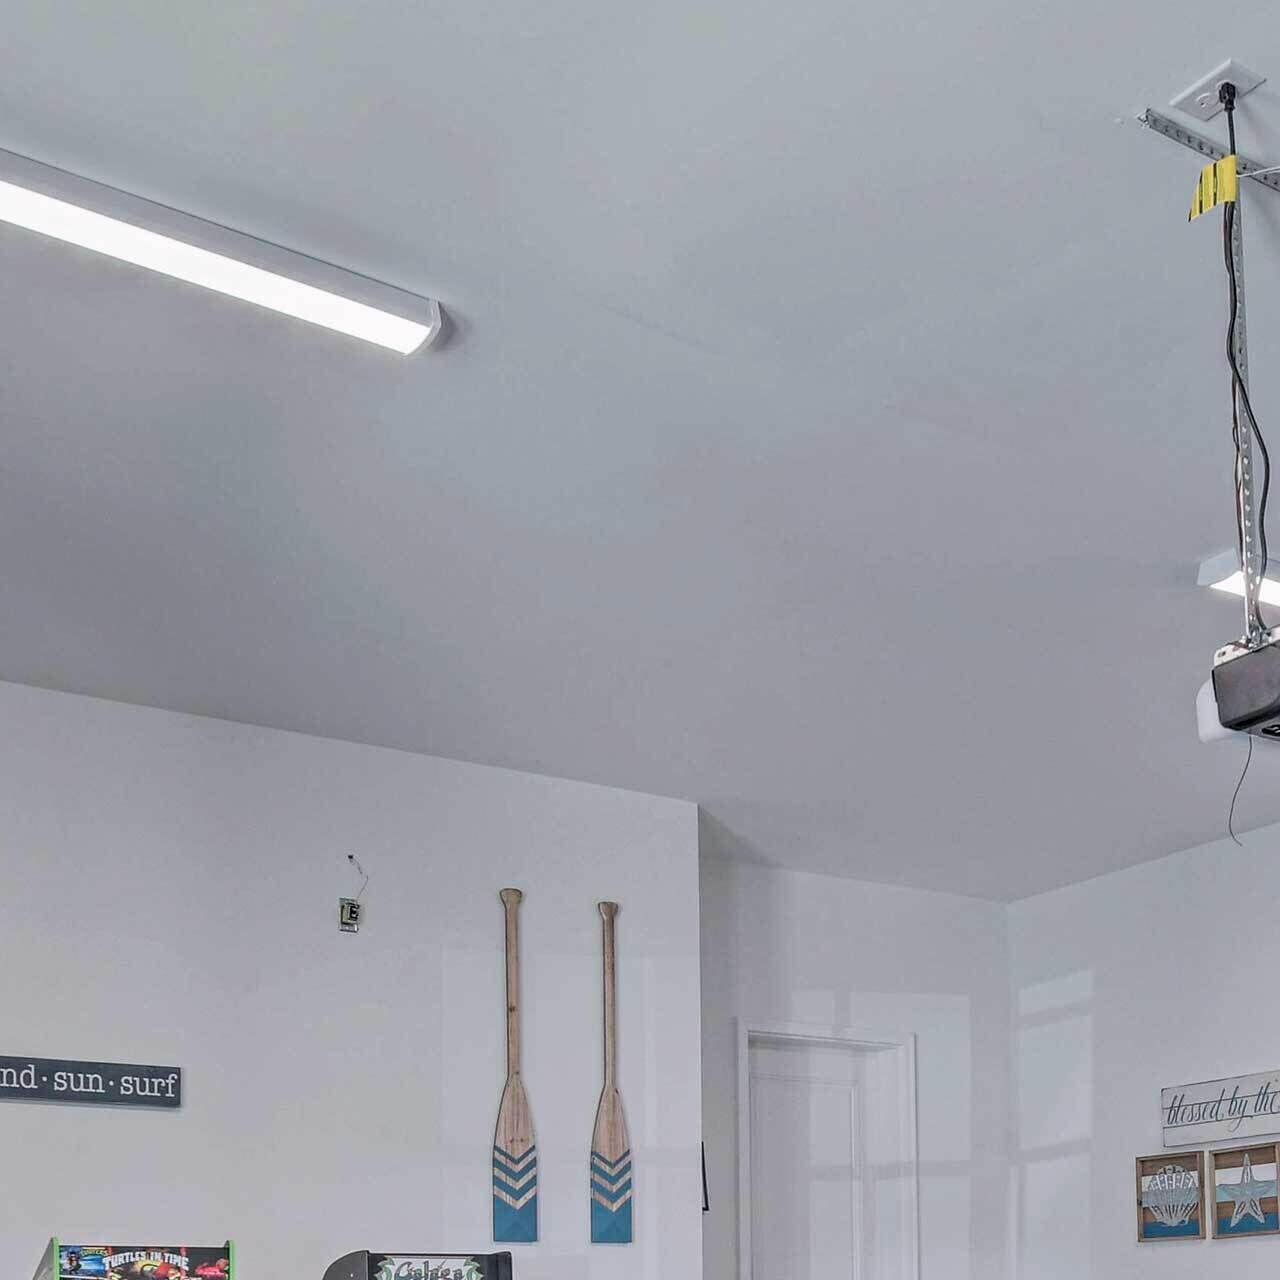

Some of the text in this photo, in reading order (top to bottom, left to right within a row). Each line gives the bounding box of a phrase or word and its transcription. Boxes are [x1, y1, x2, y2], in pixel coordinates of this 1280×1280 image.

[53, 1071, 106, 1093] sun
[120, 1074, 178, 1098] surf
[1167, 1088, 1225, 1125] blessed
[1227, 1085, 1254, 1132] by
[1253, 1082, 1280, 1114] the
[102, 1251, 190, 1271] TURTLES IN TIME
